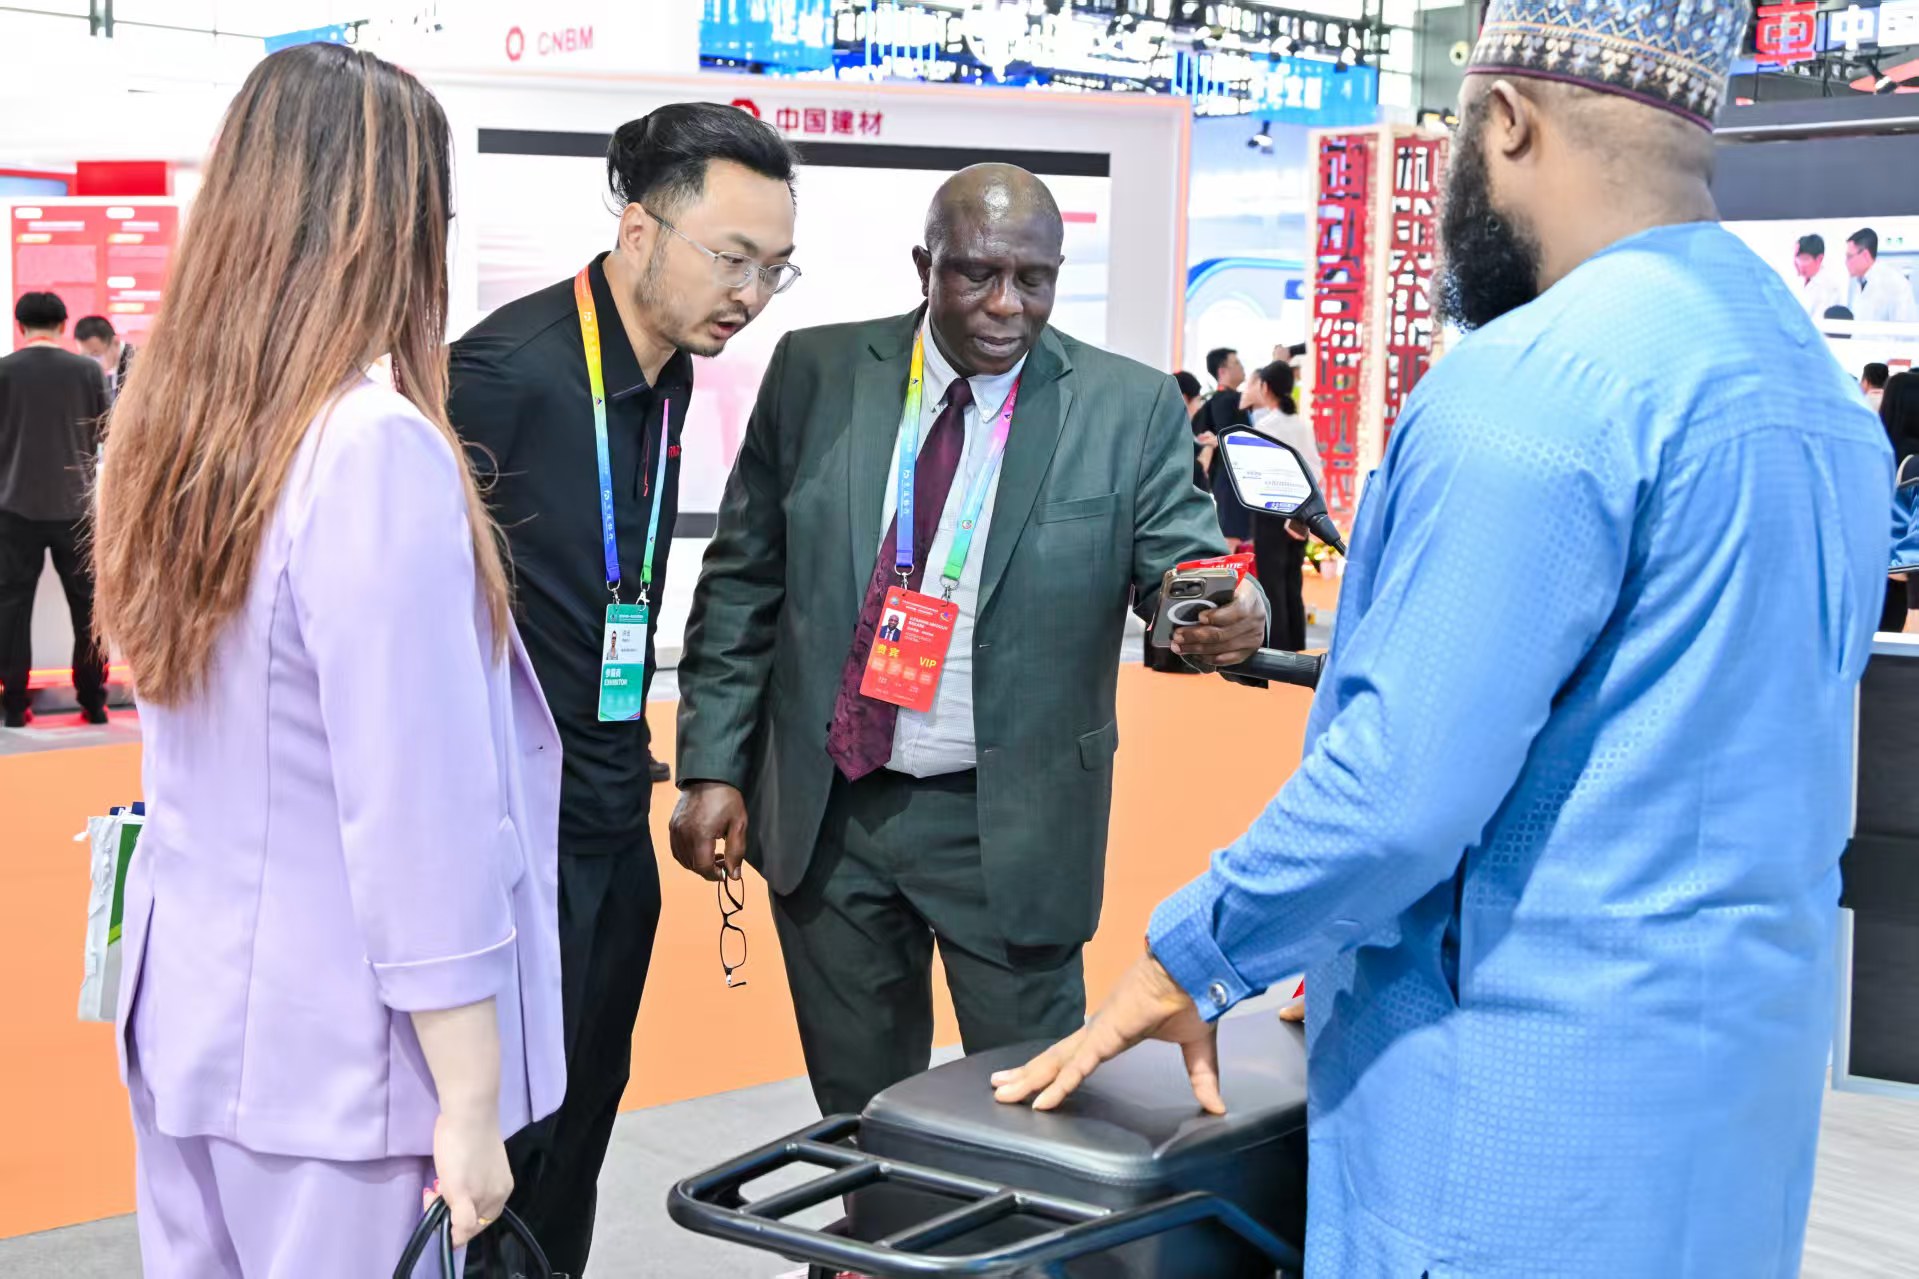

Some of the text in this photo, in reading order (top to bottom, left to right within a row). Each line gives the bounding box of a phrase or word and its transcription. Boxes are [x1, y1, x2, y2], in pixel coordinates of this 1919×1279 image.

[538, 25, 594, 55] CNBM
[776, 107, 883, 136] 中国建材
[919, 656, 937, 669] VIP
